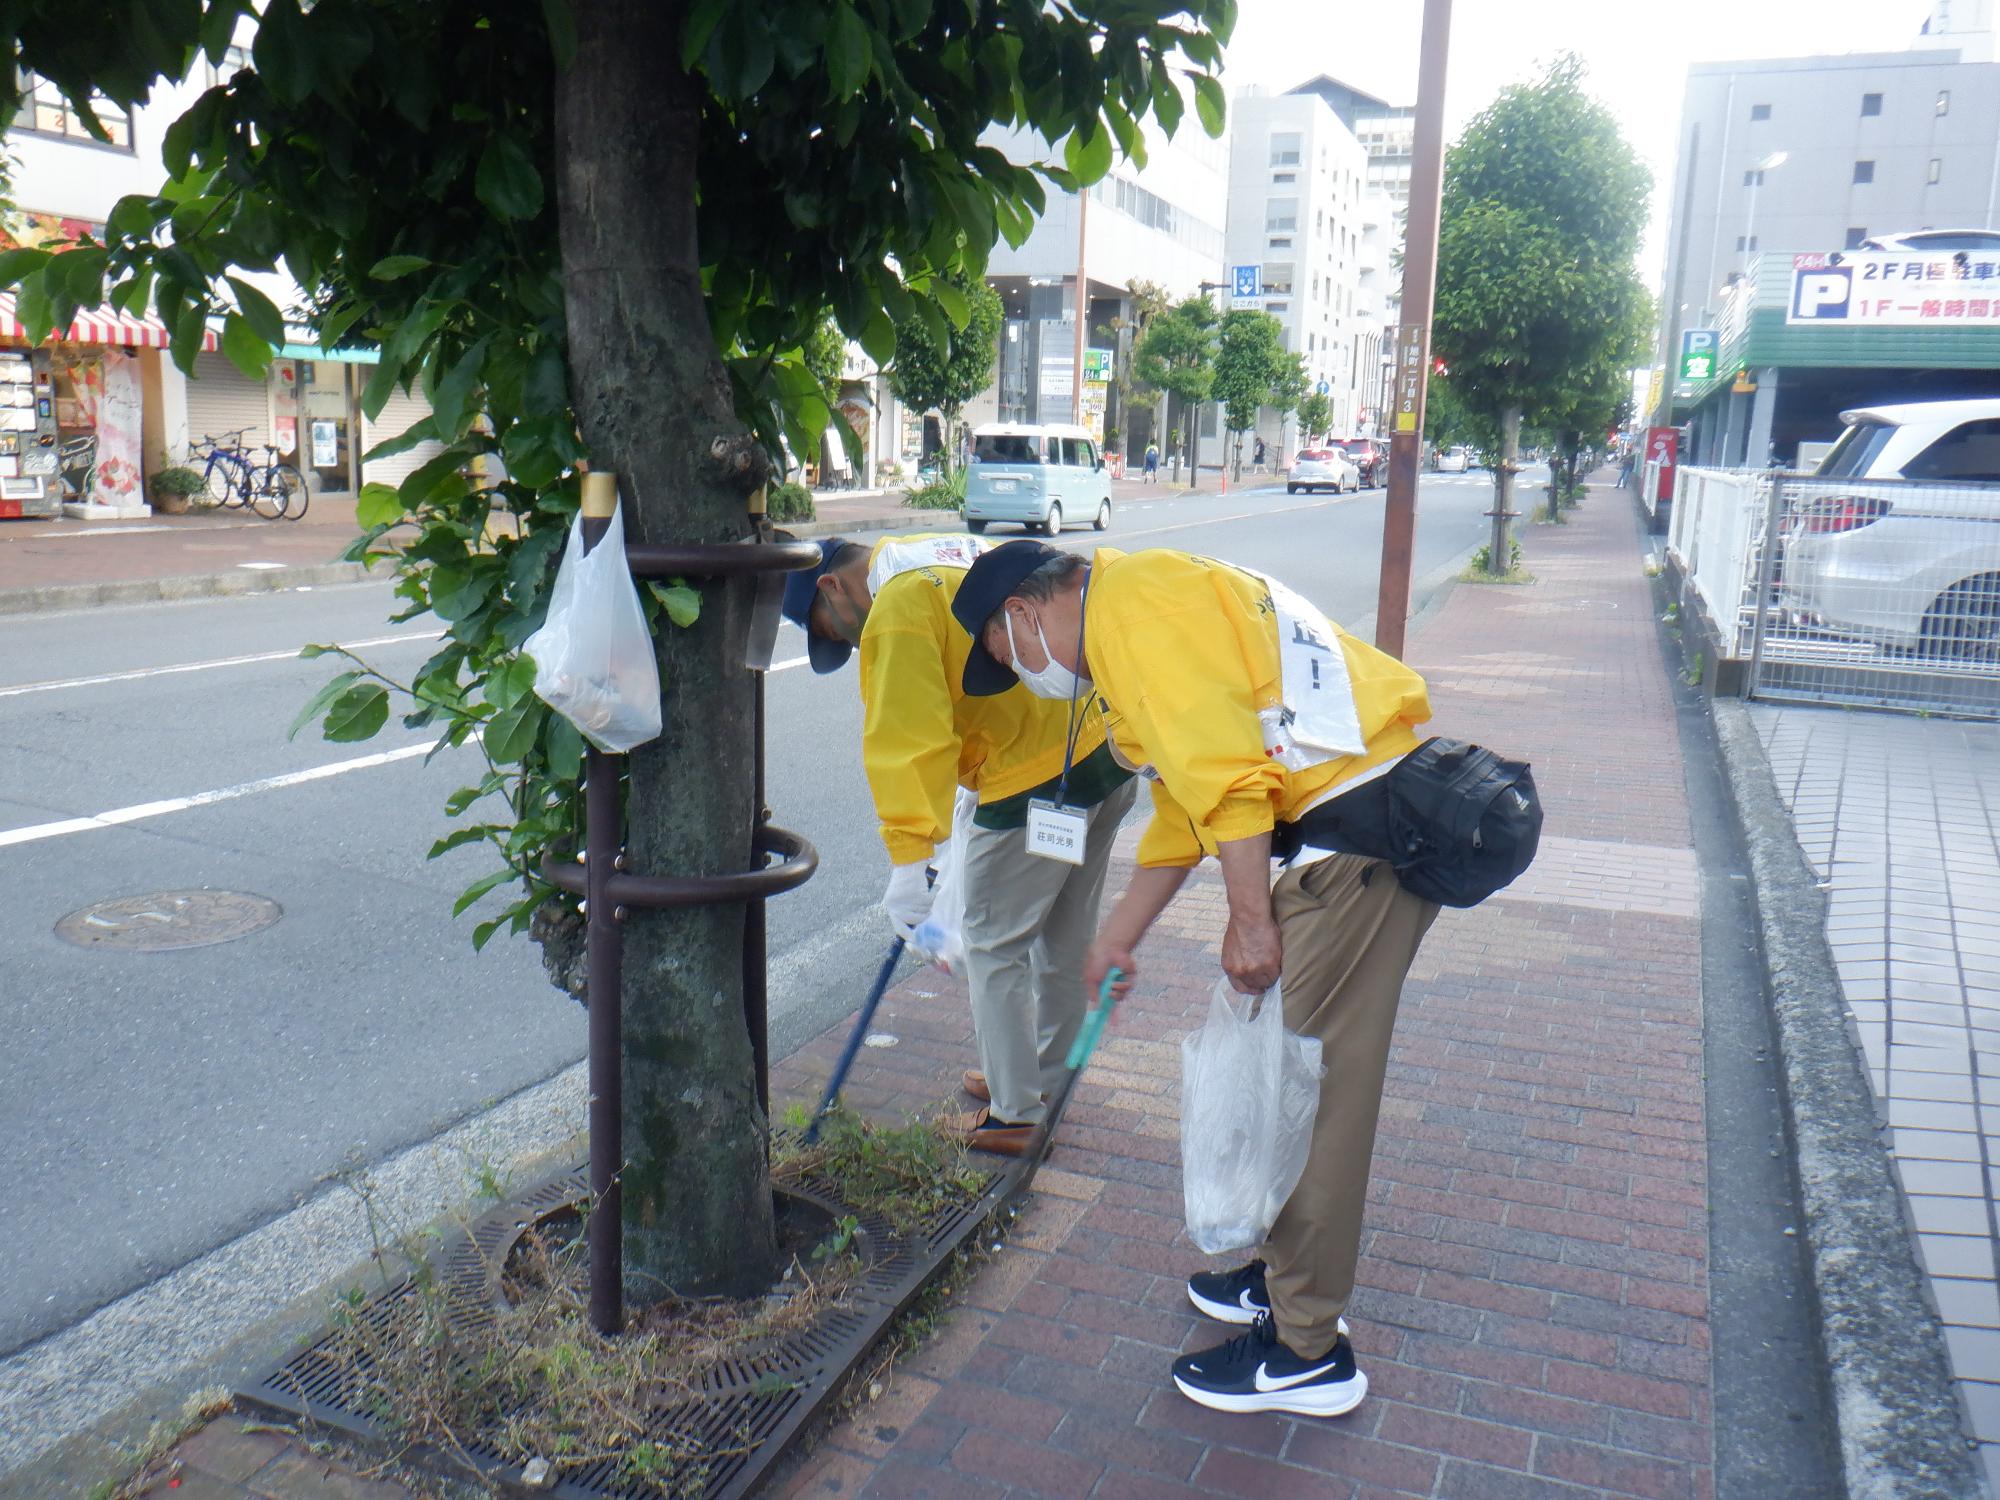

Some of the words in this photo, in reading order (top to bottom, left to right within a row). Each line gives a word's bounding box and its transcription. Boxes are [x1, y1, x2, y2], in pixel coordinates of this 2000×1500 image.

[1798, 274, 1850, 318] P
[1689, 332, 1713, 354] P
[1101, 354, 1109, 369] P
[1404, 400, 1412, 412] 3
